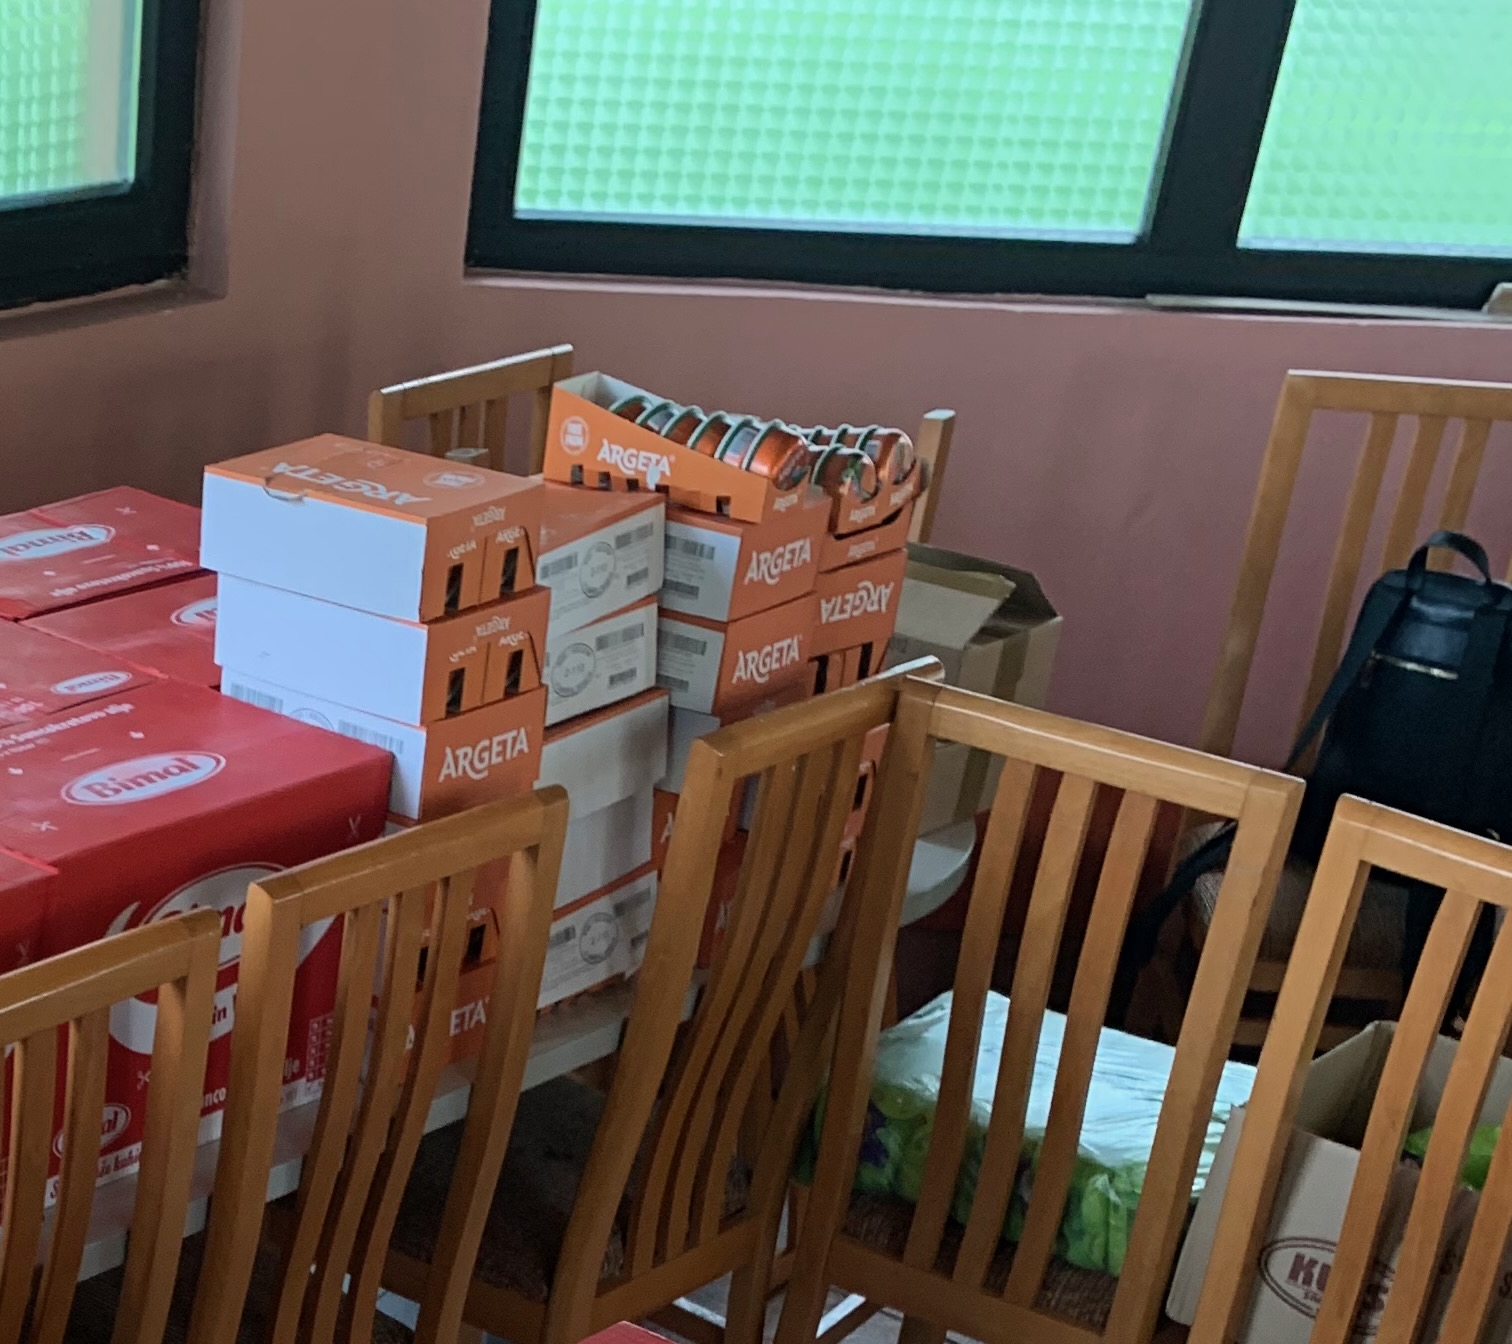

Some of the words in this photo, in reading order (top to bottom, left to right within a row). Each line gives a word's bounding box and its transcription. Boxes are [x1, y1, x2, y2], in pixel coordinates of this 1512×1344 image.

[597, 439, 671, 477] ARGETA
[272, 462, 431, 504] ARGETA
[745, 539, 811, 585] ARGETA
[821, 582, 893, 624] ARGETA
[733, 638, 799, 683] ARGETA
[440, 727, 529, 780] ARGETA
[85, 757, 199, 800] Bimal
